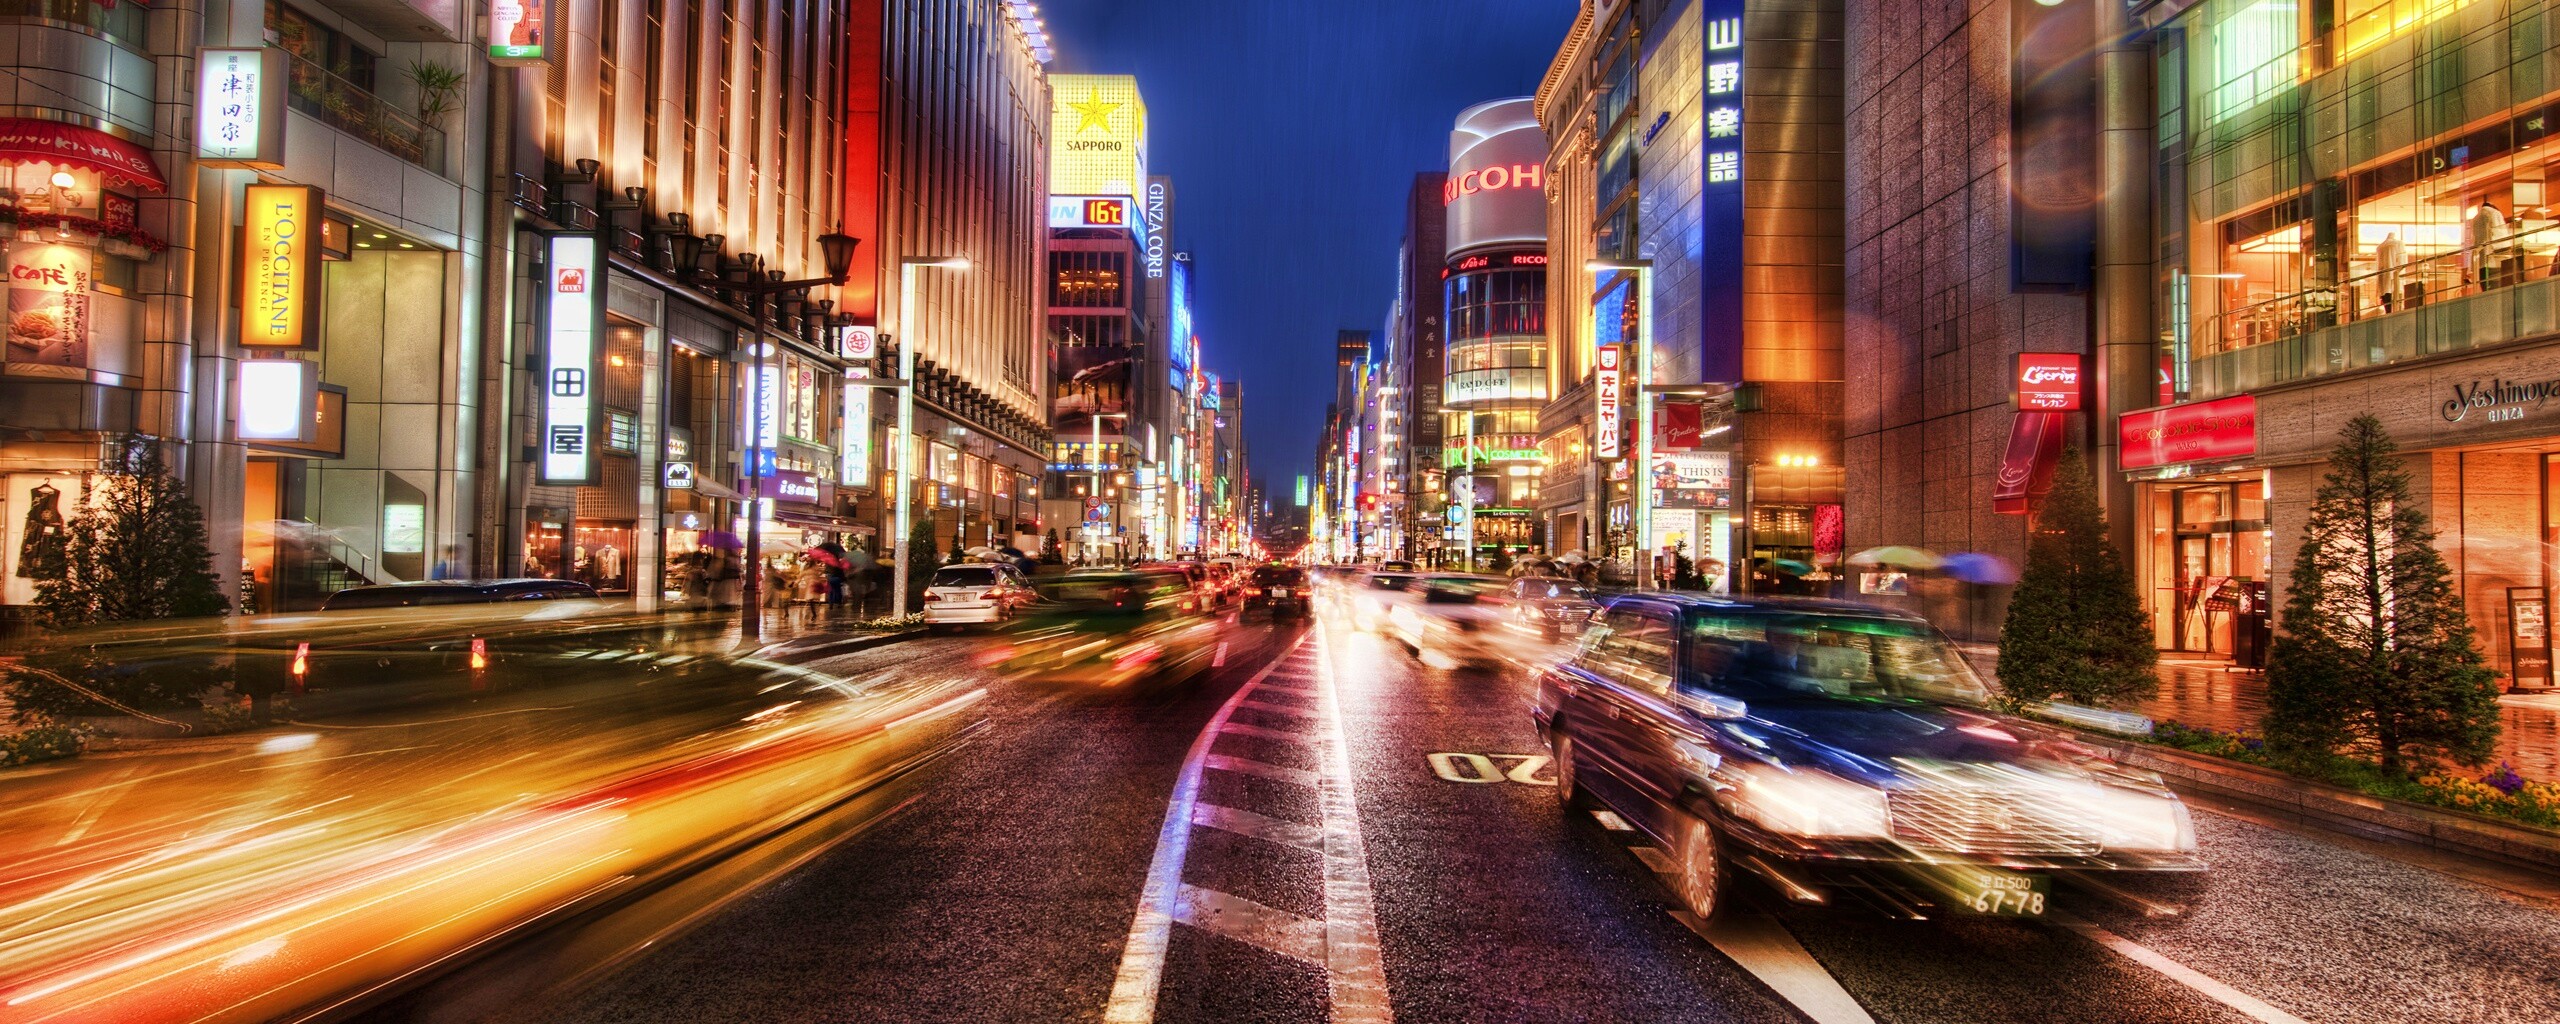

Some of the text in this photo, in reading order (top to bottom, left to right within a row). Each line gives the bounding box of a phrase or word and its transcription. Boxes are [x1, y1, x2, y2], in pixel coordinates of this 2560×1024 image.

[1709, 17, 1739, 183] 山野楽器
[1066, 140, 1122, 152] SAPPORO
[1443, 163, 1541, 207] RICOH
[1148, 183, 1164, 279] GINZA CORE
[259, 227, 271, 312] EN PROVENCE
[1456, 380, 1482, 391] RAND
[550, 367, 585, 455] 田屋
[1601, 375, 1618, 453] キムラヤのパン
[2204, 413, 2251, 432] Shop
[2487, 406, 2524, 422] GINZA
[1668, 425, 1699, 443] Fender
[1682, 467, 1724, 476] THIS IS
[1975, 889, 2045, 915] 67-78
